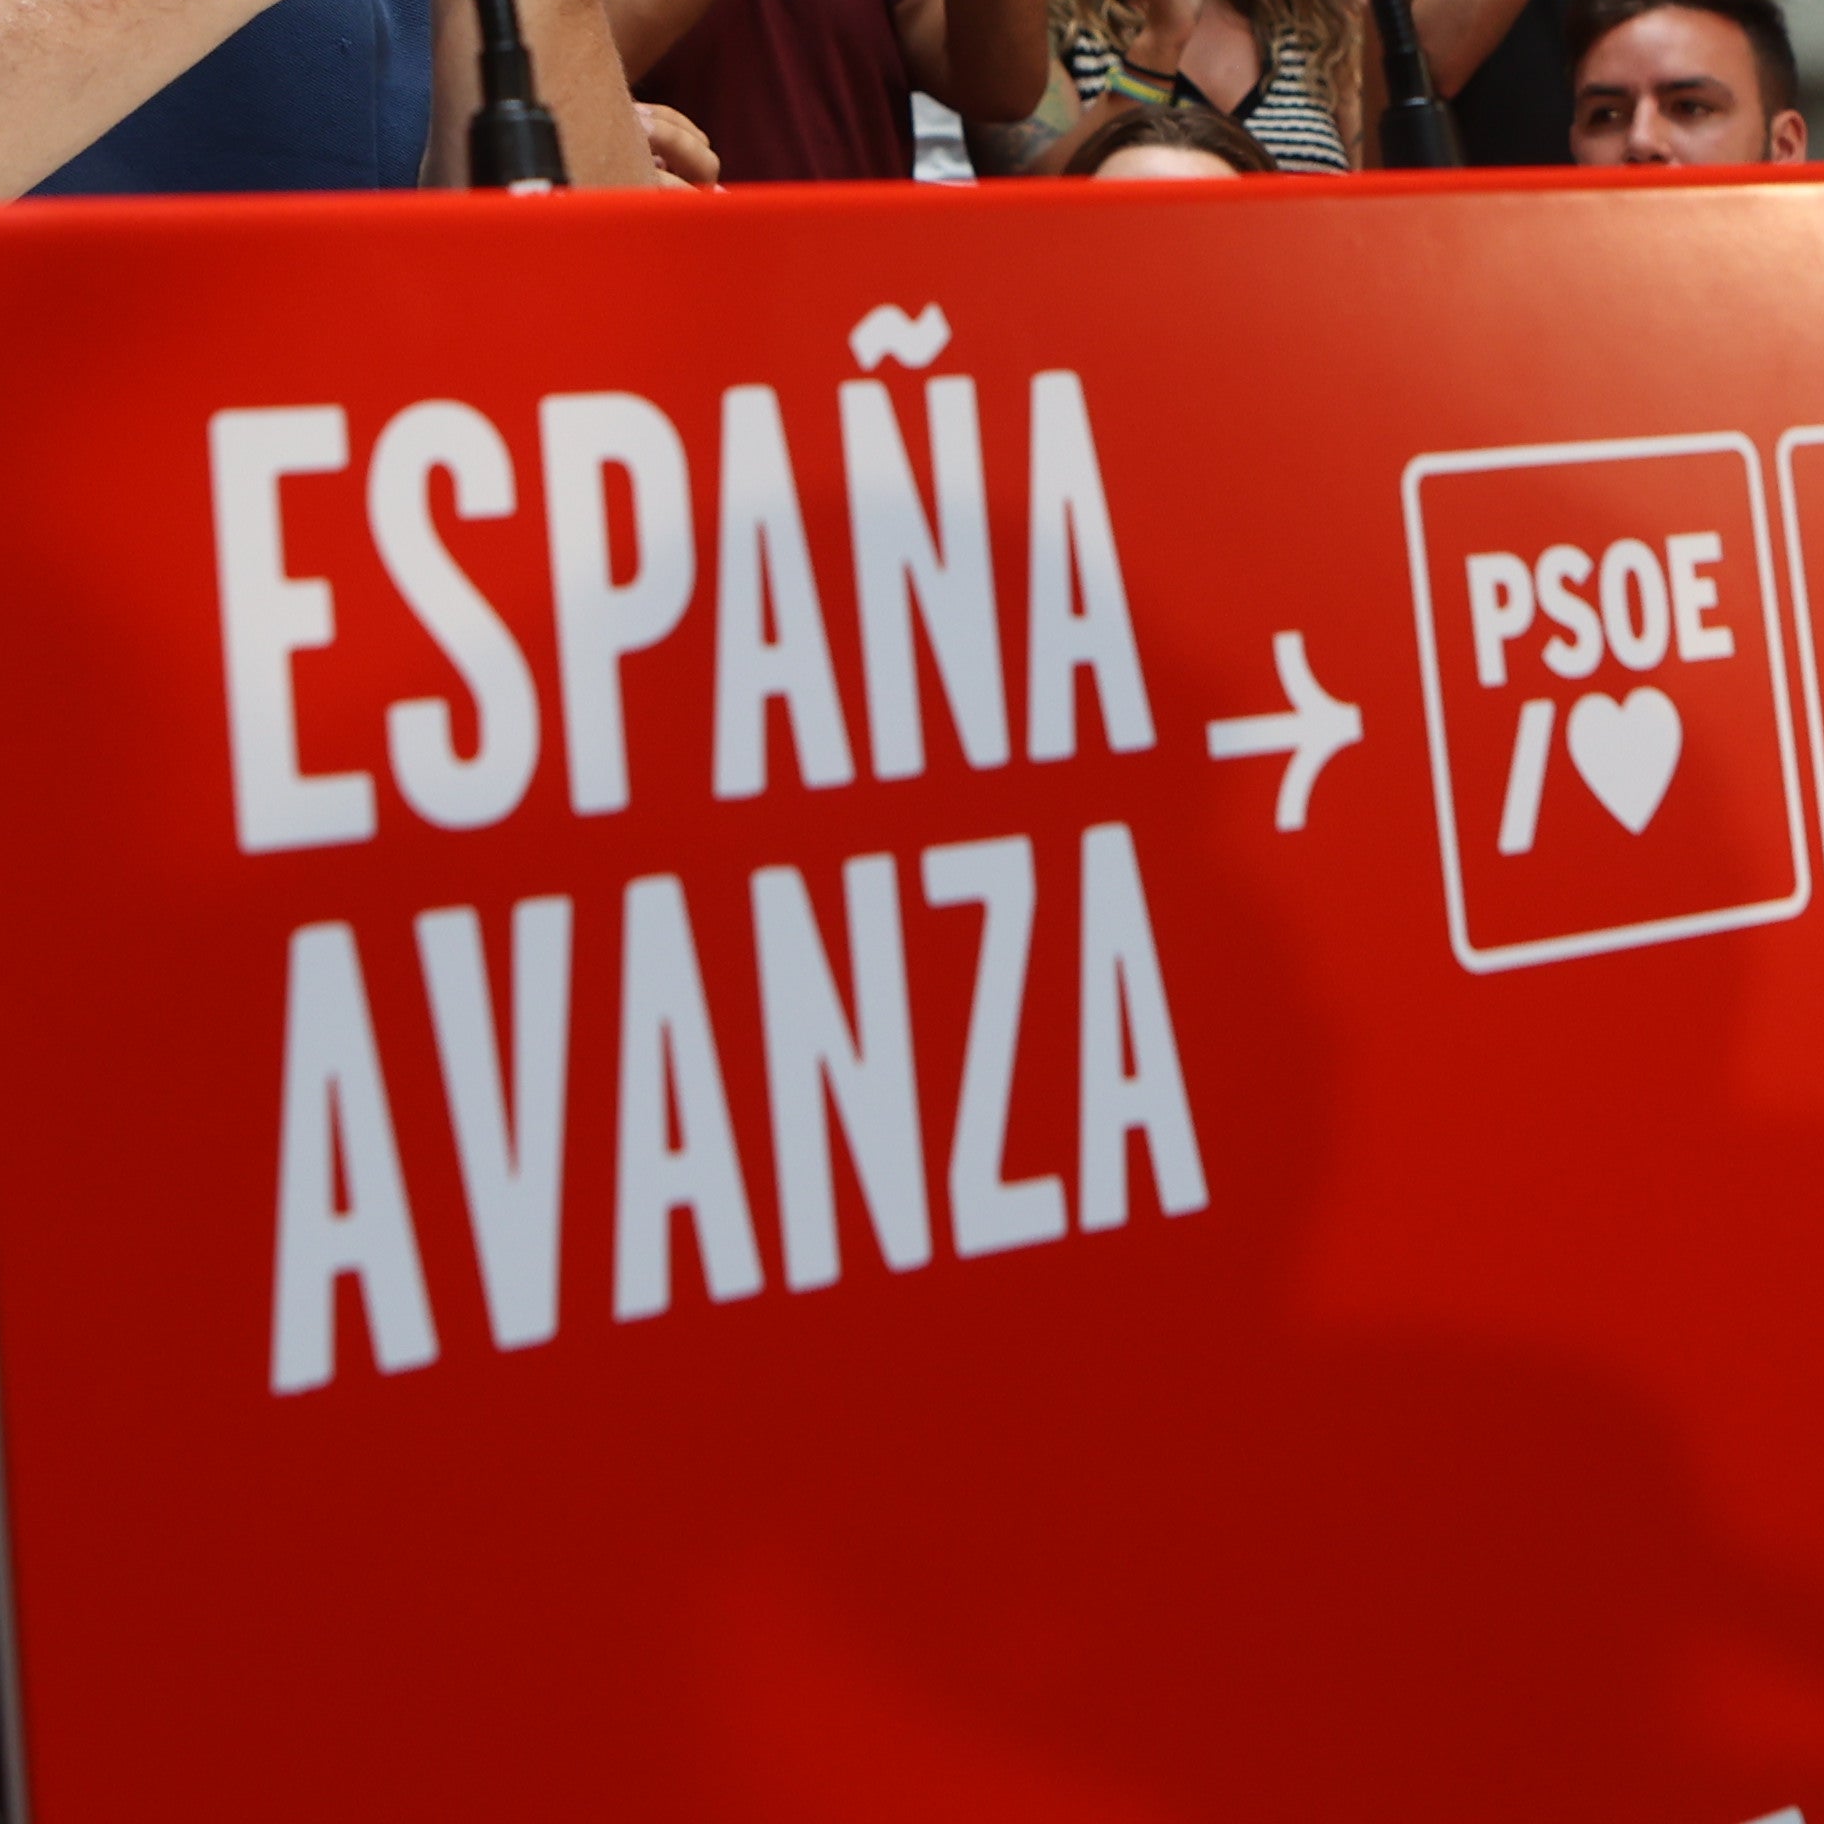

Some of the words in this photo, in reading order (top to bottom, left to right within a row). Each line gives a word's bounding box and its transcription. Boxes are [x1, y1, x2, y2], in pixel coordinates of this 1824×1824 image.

[208, 302, 1158, 855] ESPAÑA
[1465, 531, 1736, 688] PSOE
[269, 821, 1210, 1396] AVANZA
